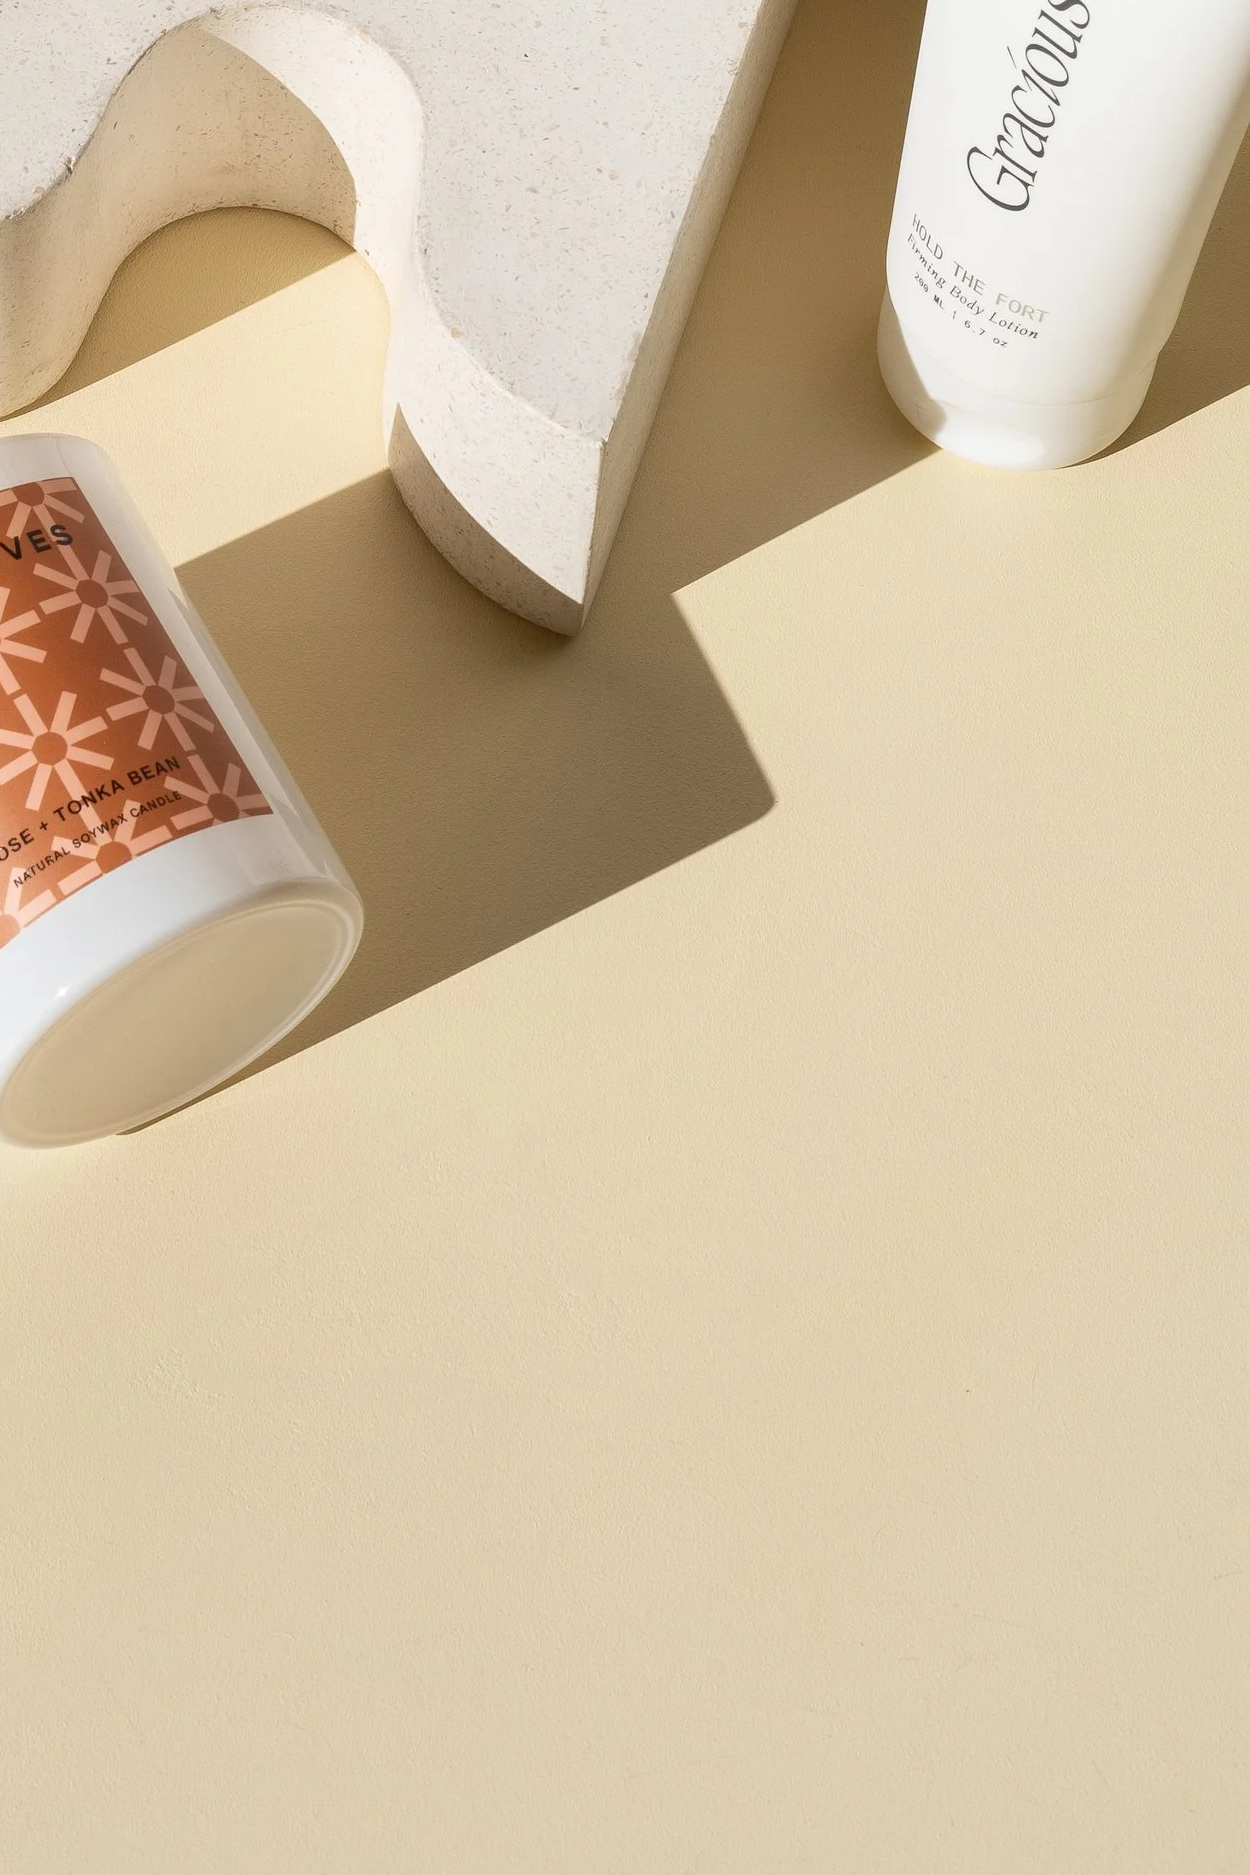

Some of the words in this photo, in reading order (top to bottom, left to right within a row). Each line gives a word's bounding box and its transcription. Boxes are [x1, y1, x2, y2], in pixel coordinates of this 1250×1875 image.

[907, 233, 946, 289] Firming
[949, 285, 985, 316] Body
[989, 312, 1039, 339] Lotion
[912, 213, 944, 260] HOLD
[953, 261, 986, 295] THE
[995, 292, 1050, 323] FORT
[914, 271, 929, 292] 200
[933, 294, 945, 310] ML
[964, 320, 986, 336] 6.7
[992, 337, 1009, 348] oz
[53, 779, 125, 822] TONKA
[126, 756, 181, 786] BEAN
[13, 846, 71, 888] NATURAL
[72, 813, 128, 849] SOYWAX
[130, 790, 182, 818] CANDLE
